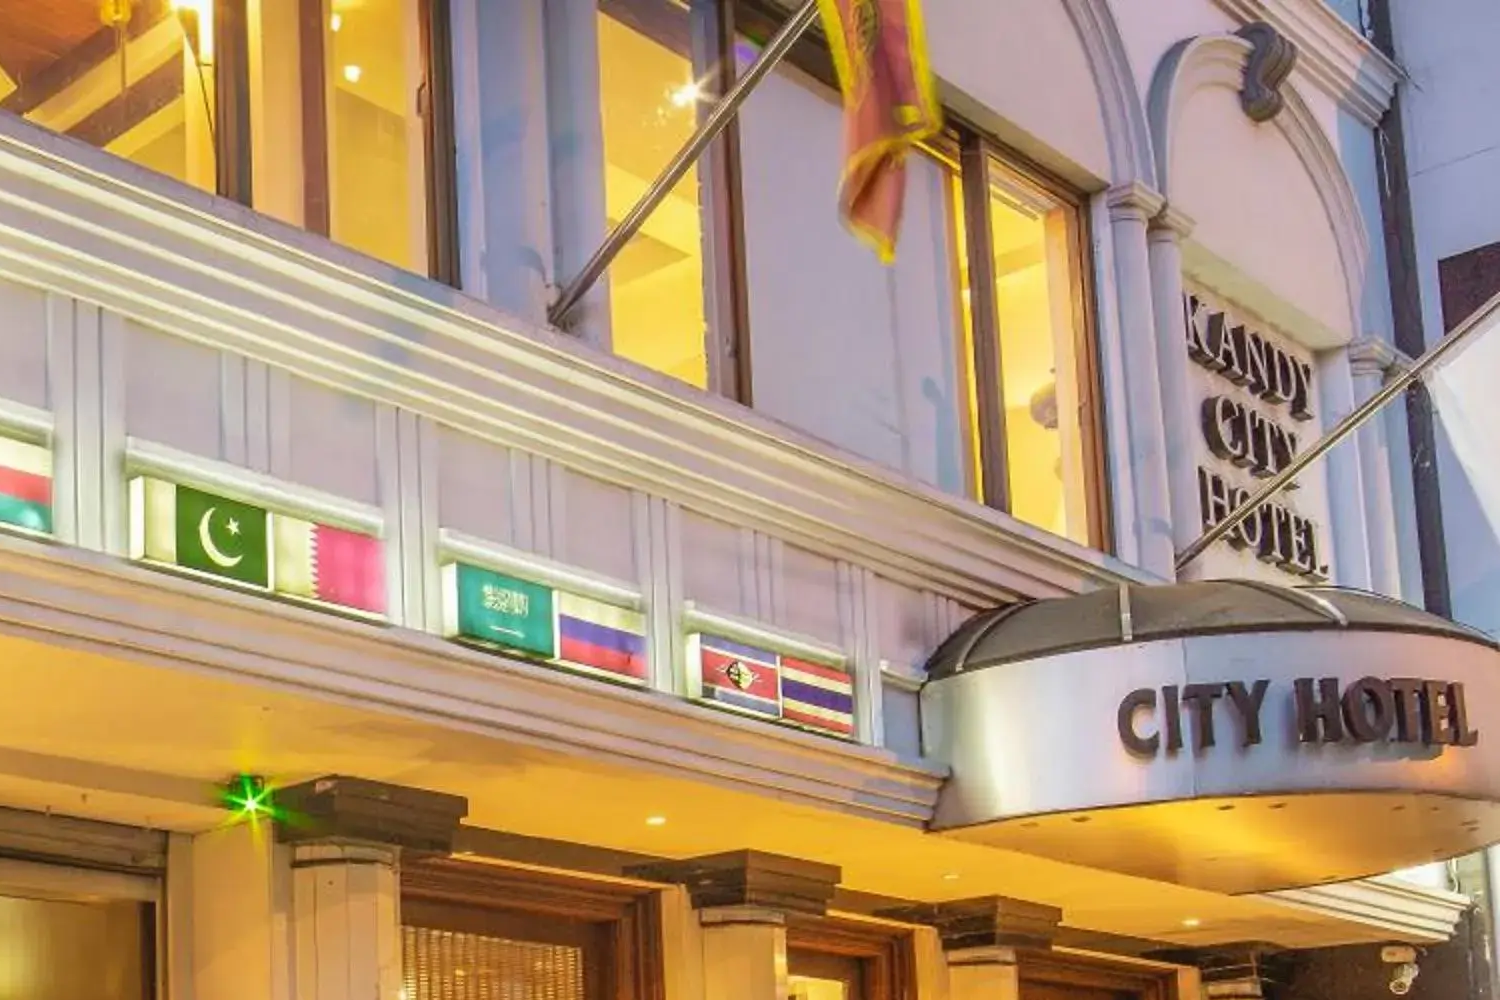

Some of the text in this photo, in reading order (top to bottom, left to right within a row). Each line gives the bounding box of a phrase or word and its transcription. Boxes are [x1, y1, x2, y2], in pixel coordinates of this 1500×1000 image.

[1183, 289, 1314, 421] KANDY
[1203, 395, 1300, 490] CITY
[1198, 465, 1329, 584] HOTEL
[1117, 675, 1479, 755] CITY HOTEL
